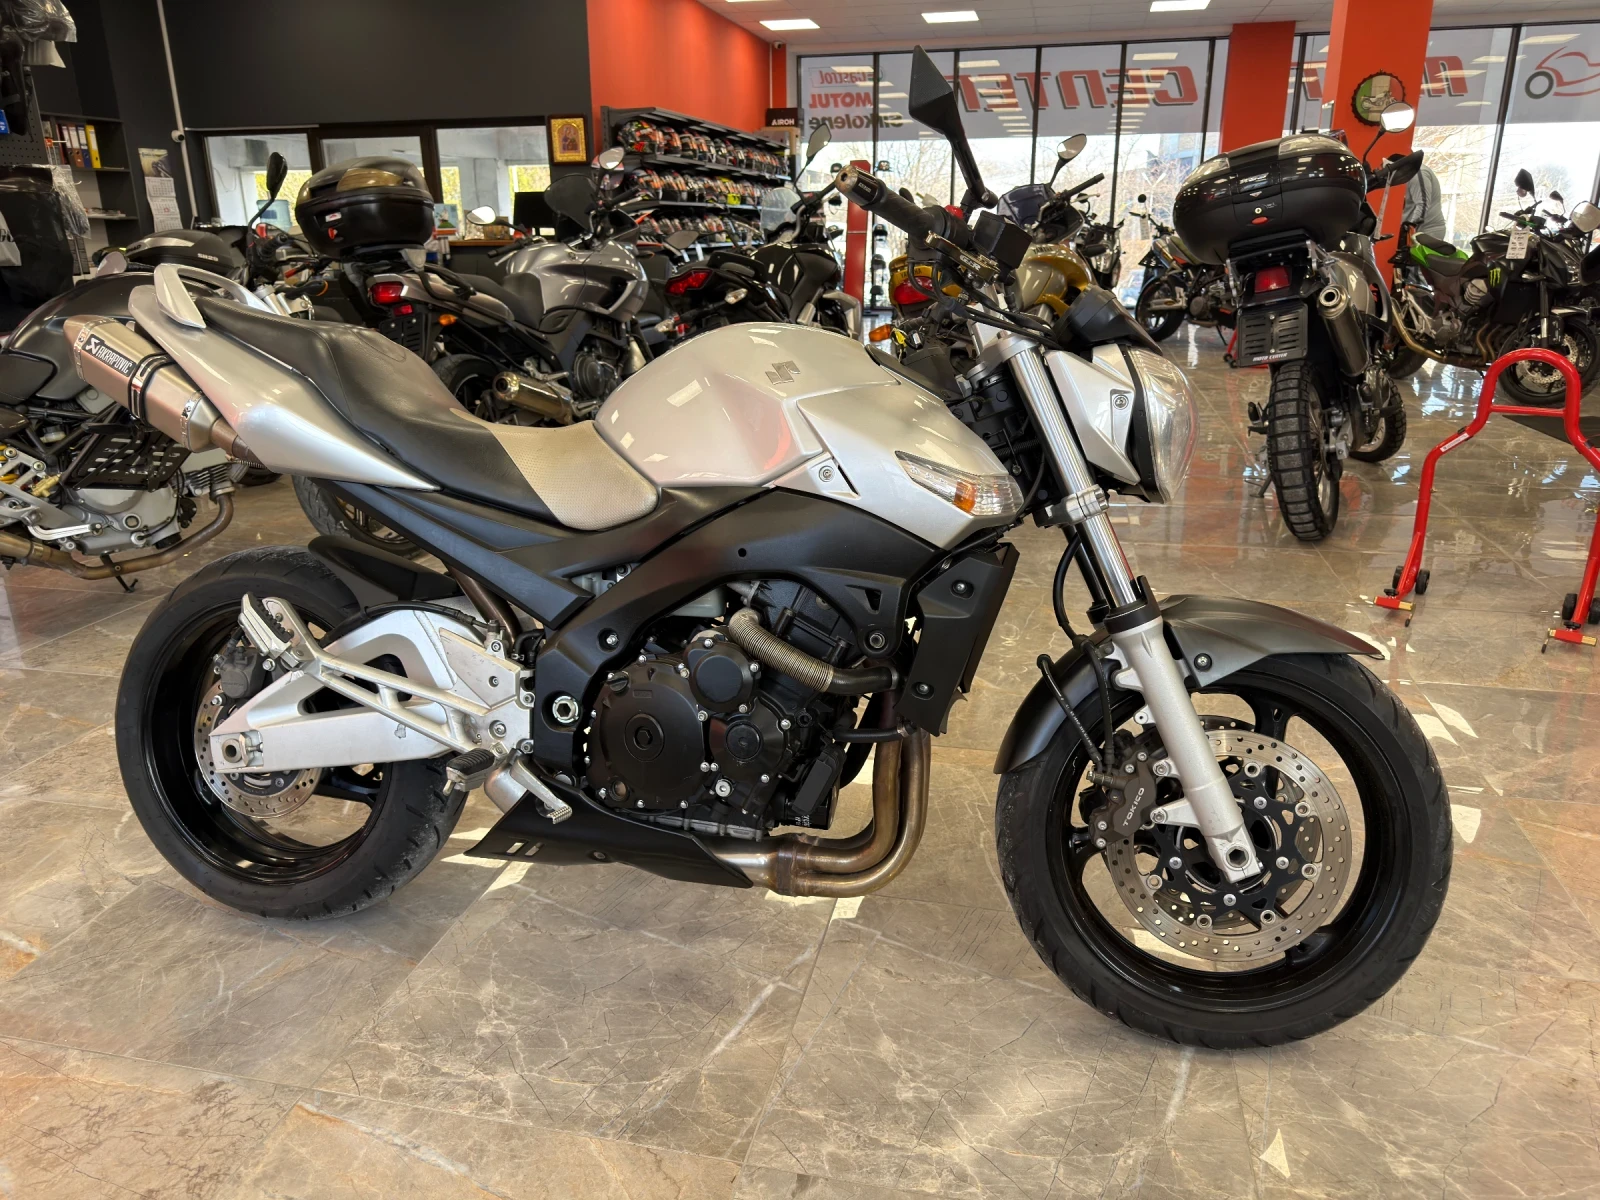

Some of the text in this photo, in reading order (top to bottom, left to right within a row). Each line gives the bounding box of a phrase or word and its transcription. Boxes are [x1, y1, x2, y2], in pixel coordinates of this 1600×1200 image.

[771, 118, 795, 126] AIROH
[901, 268, 923, 278] YAHA
[1122, 787, 1145, 827] TOKICO
